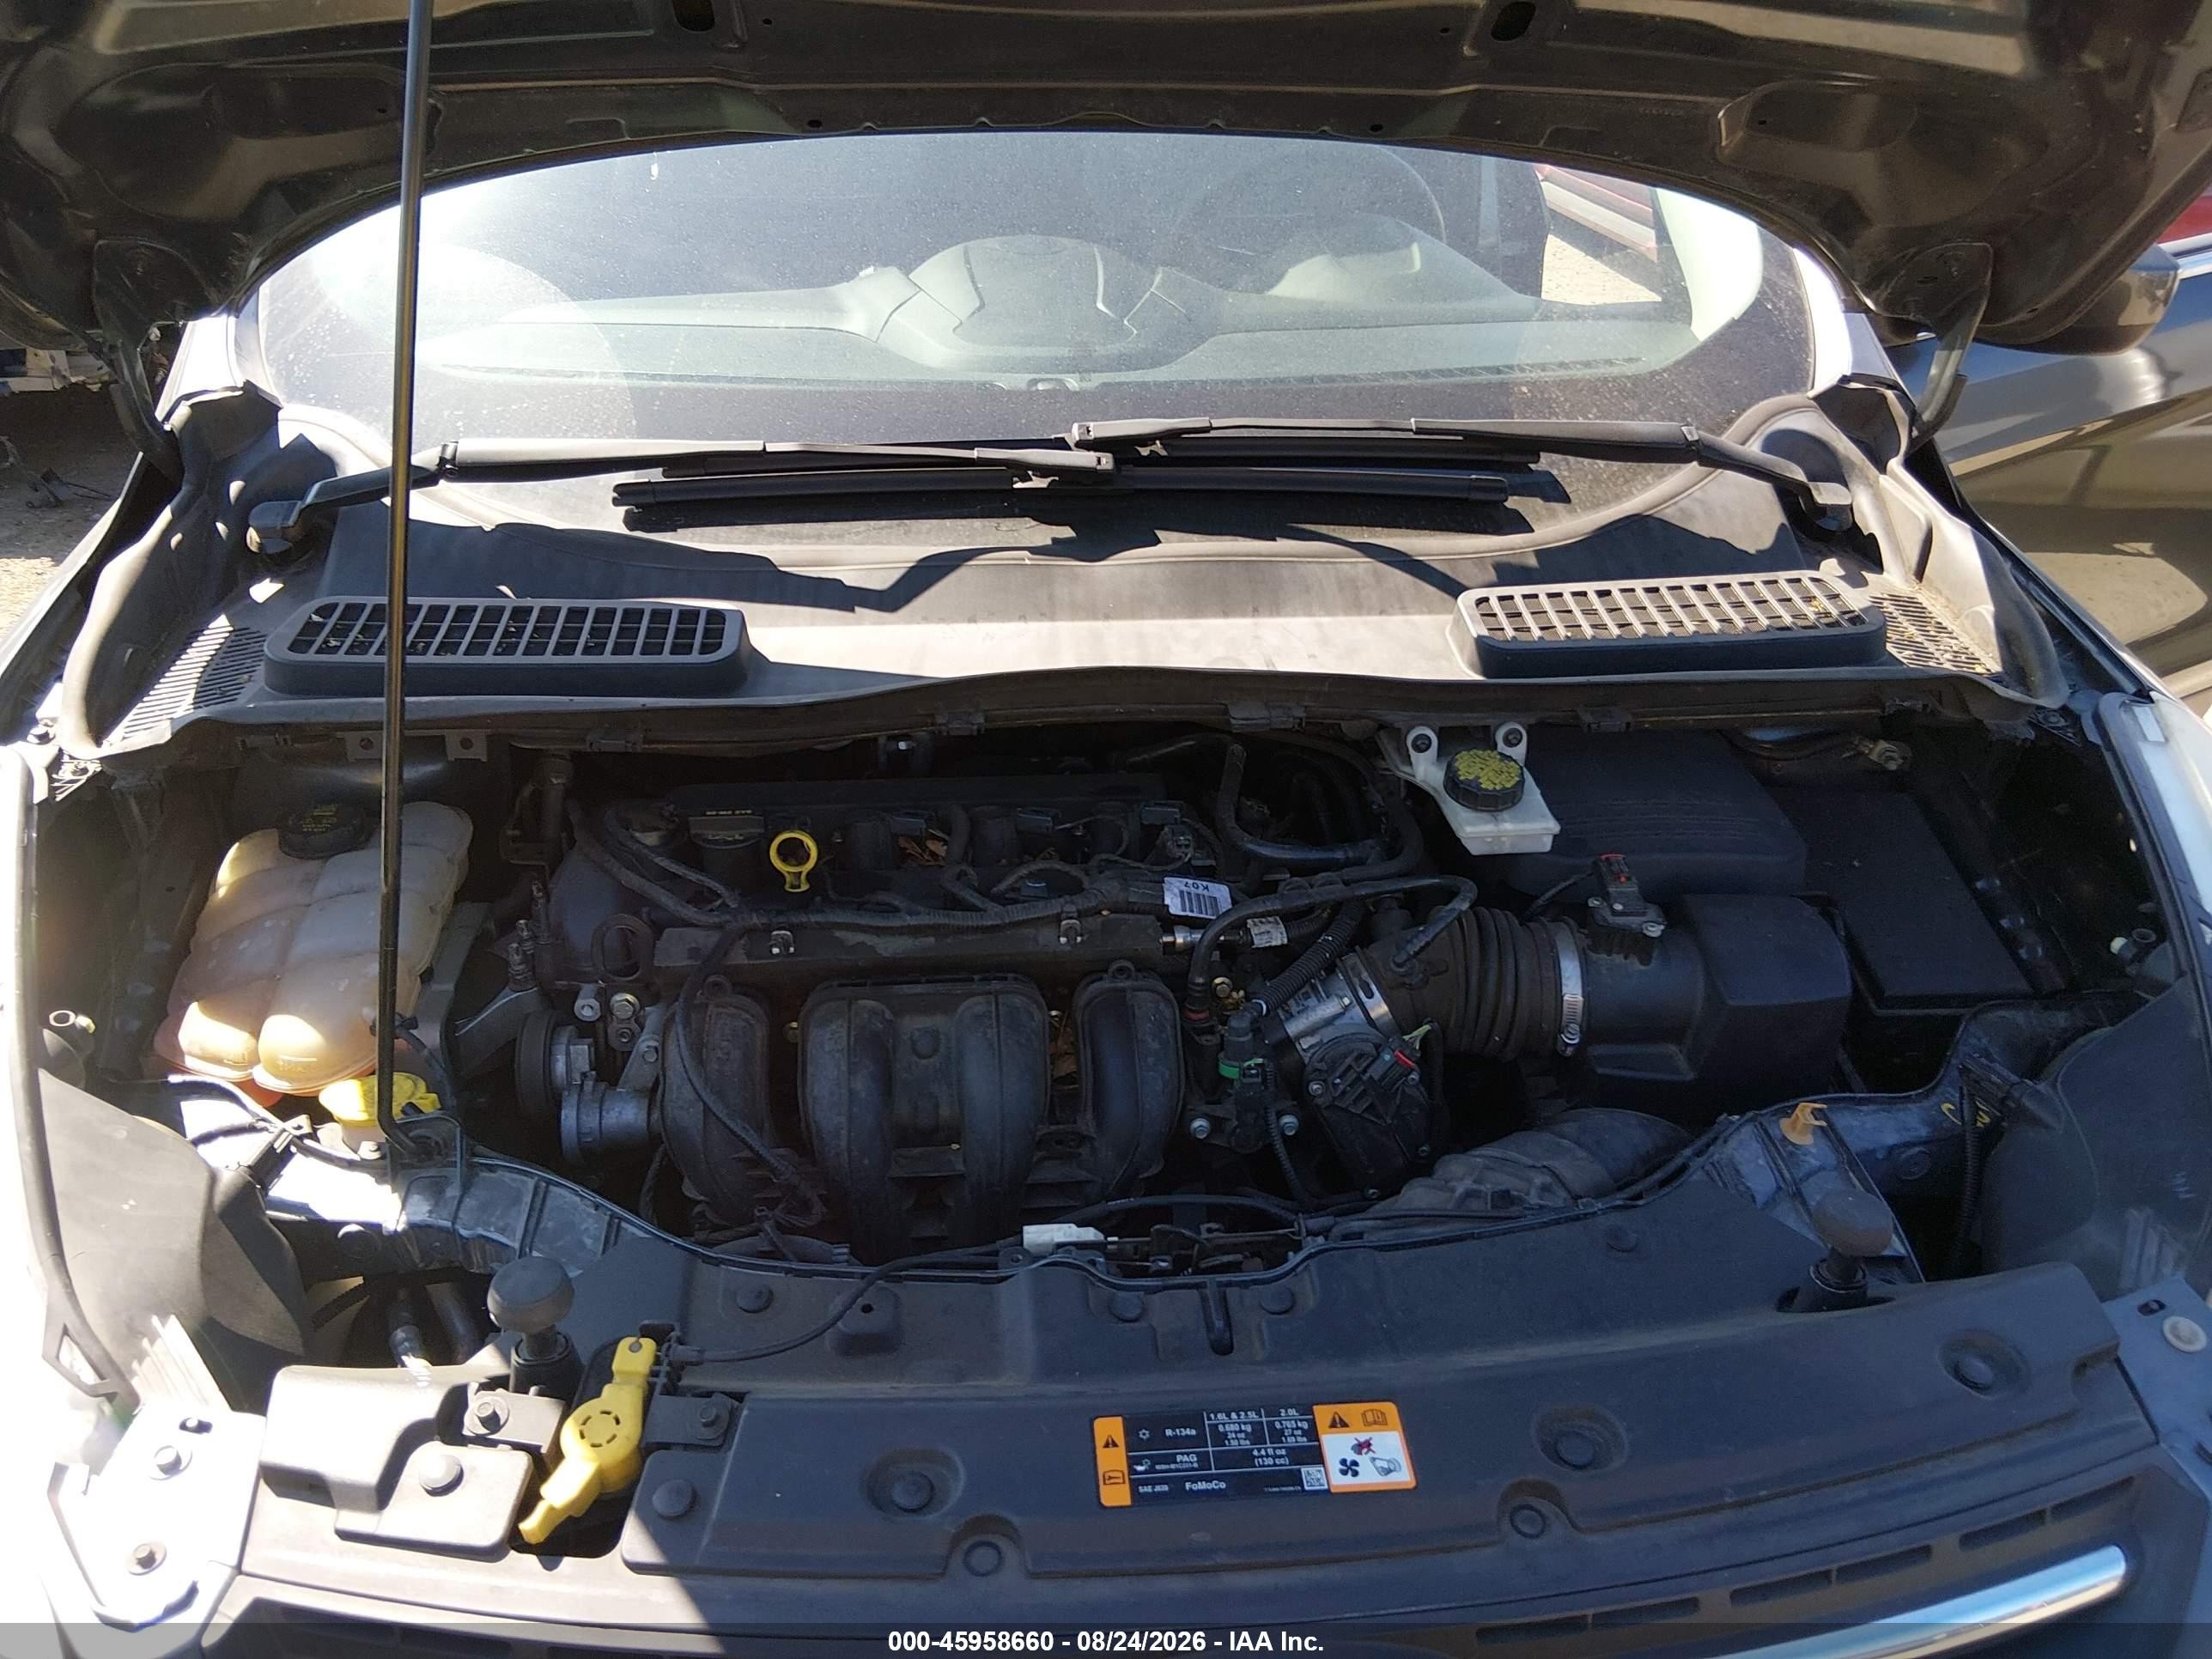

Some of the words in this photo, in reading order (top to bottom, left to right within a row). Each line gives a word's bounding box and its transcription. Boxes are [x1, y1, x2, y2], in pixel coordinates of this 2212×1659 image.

[1183, 881, 1210, 892] K07
[1241, 1423, 1252, 1432] kg
[1297, 1420, 1309, 1430] kg
[1165, 1427, 1196, 1437] R-134a
[1176, 1454, 1198, 1463] PAG
[1255, 1457, 1274, 1467] (130
[1275, 1455, 1289, 1466] cc)
[1138, 1485, 1153, 1493] SAE
[1185, 1480, 1226, 1492] FoMoCo
